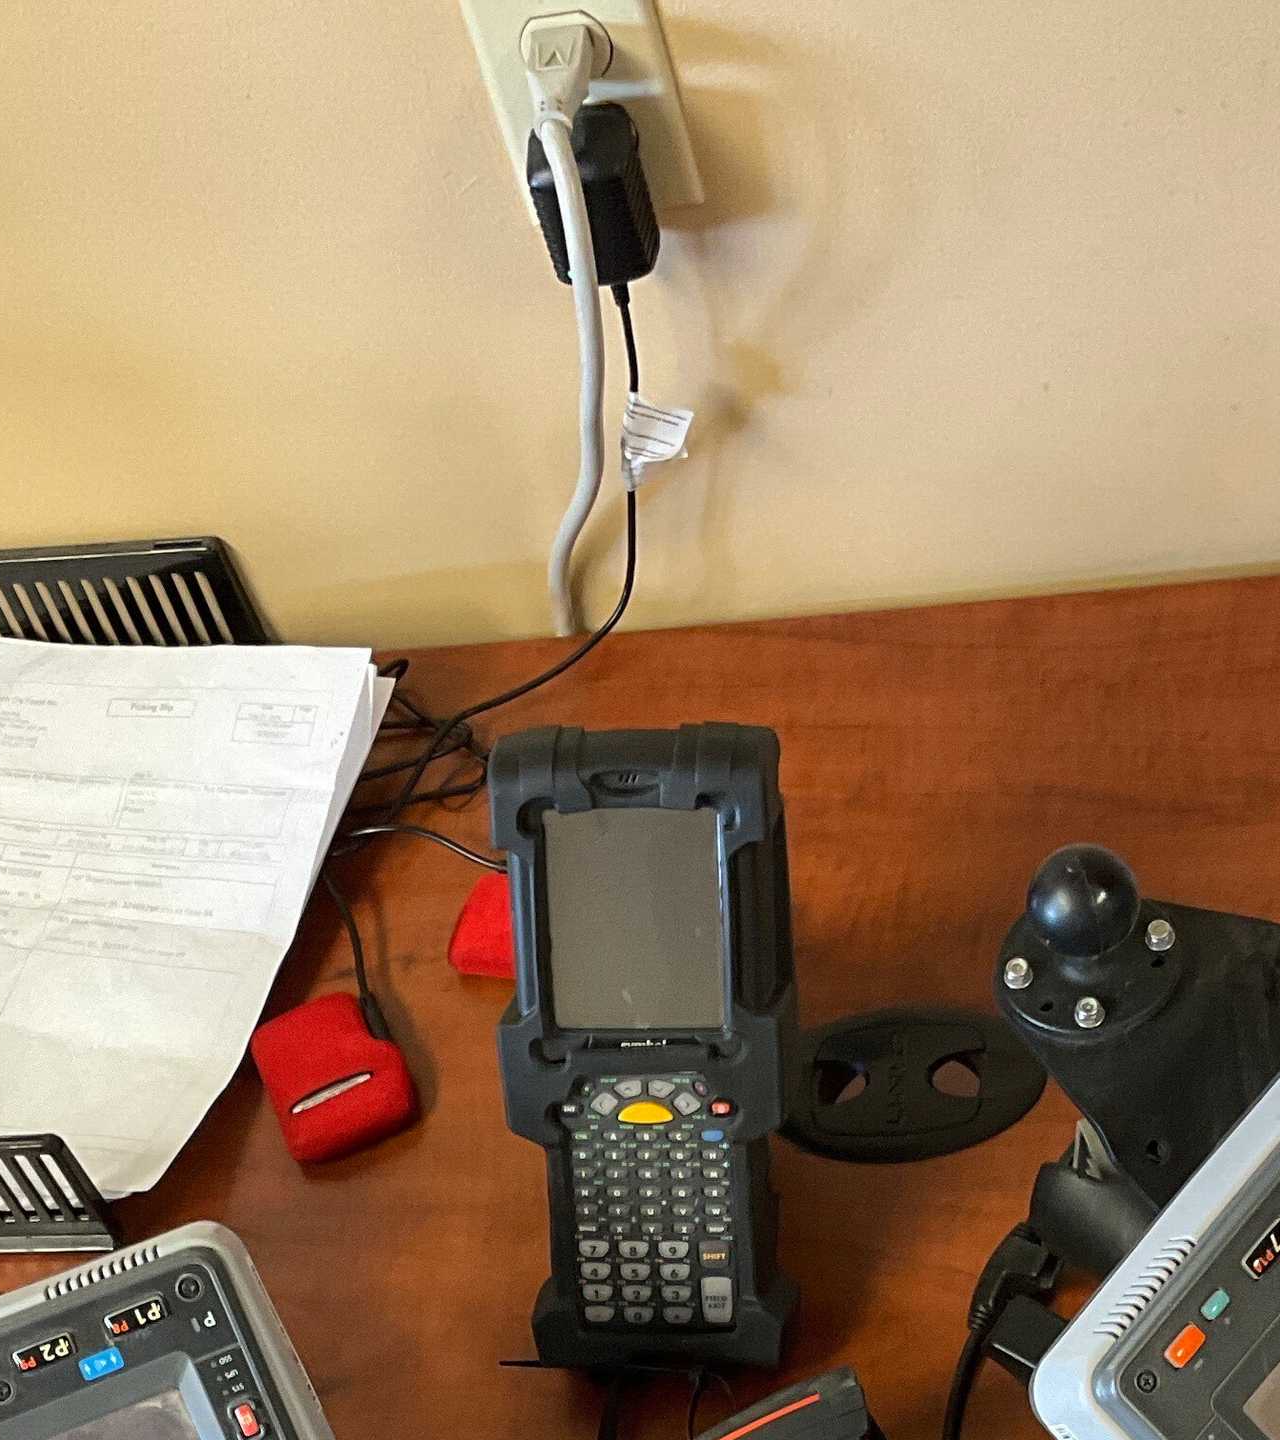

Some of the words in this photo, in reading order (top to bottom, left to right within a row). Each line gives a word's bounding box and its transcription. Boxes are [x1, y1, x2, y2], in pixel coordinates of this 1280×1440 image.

[703, 1252, 726, 1260] SHIFT
[135, 1298, 161, 1325] P1
[113, 1319, 129, 1335] P8
[40, 1337, 70, 1362] P2
